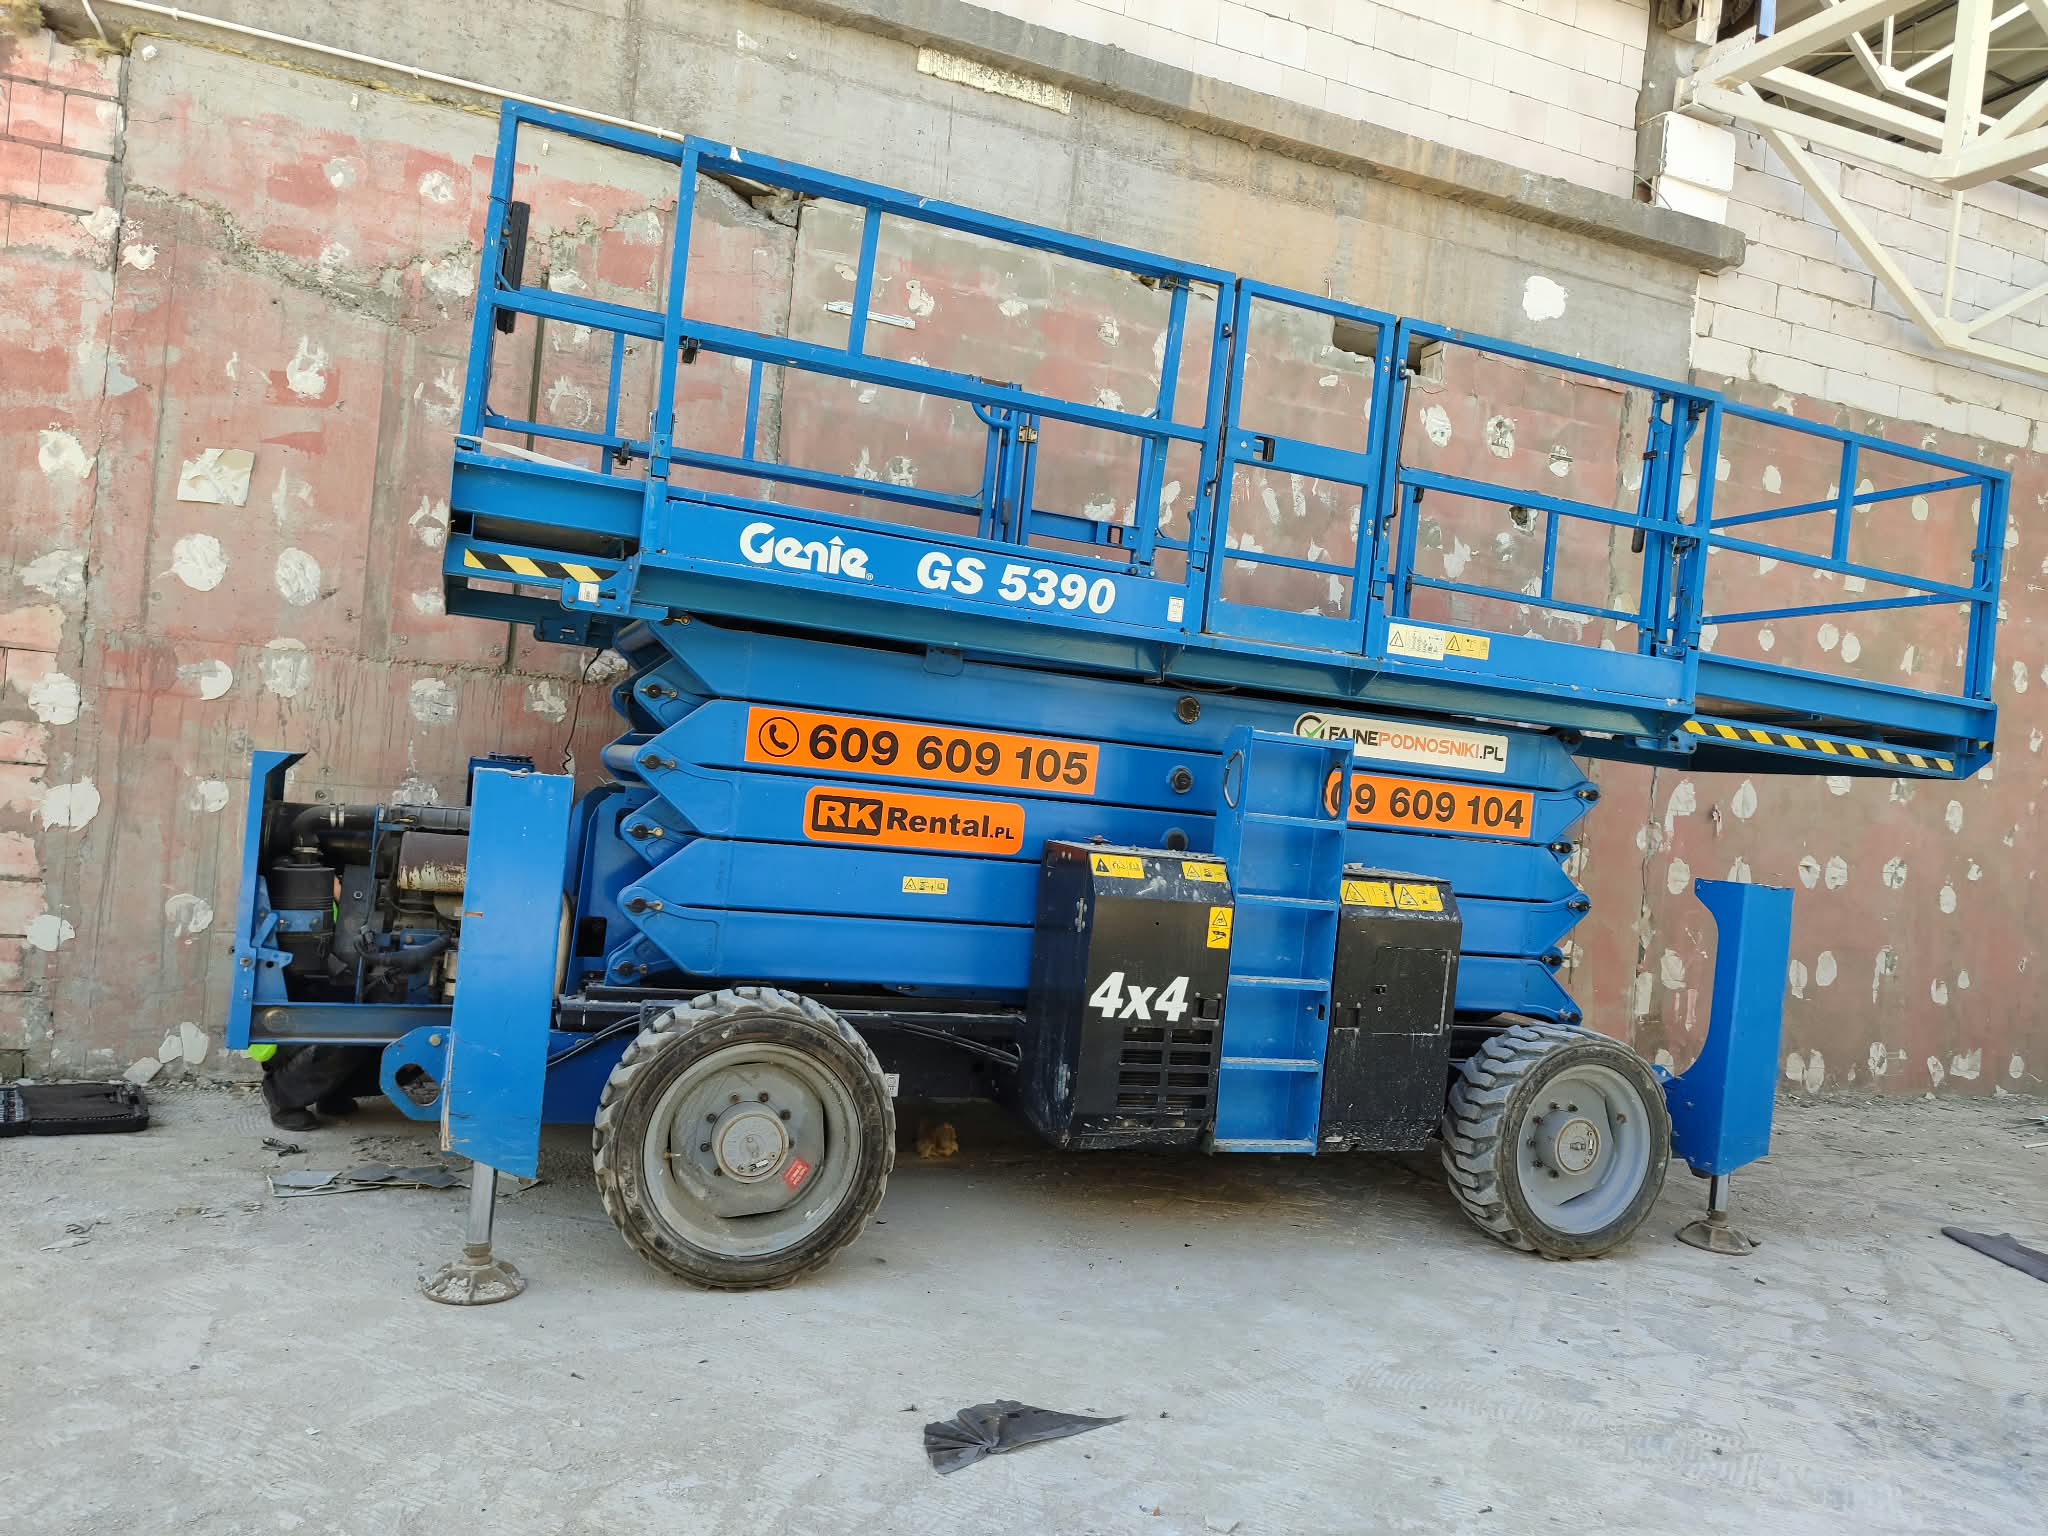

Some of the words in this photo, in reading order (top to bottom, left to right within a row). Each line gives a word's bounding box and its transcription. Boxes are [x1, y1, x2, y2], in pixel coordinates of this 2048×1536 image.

[739, 522, 869, 579] Genie
[916, 551, 986, 595] GS
[997, 564, 1116, 614] 5390
[808, 724, 900, 766] 609
[915, 735, 1001, 777] 609
[1015, 746, 1089, 786] 105
[1330, 783, 1376, 815] 09
[1389, 787, 1456, 822] 609
[1467, 795, 1524, 829] 104
[1088, 971, 1190, 1022] 4x4
